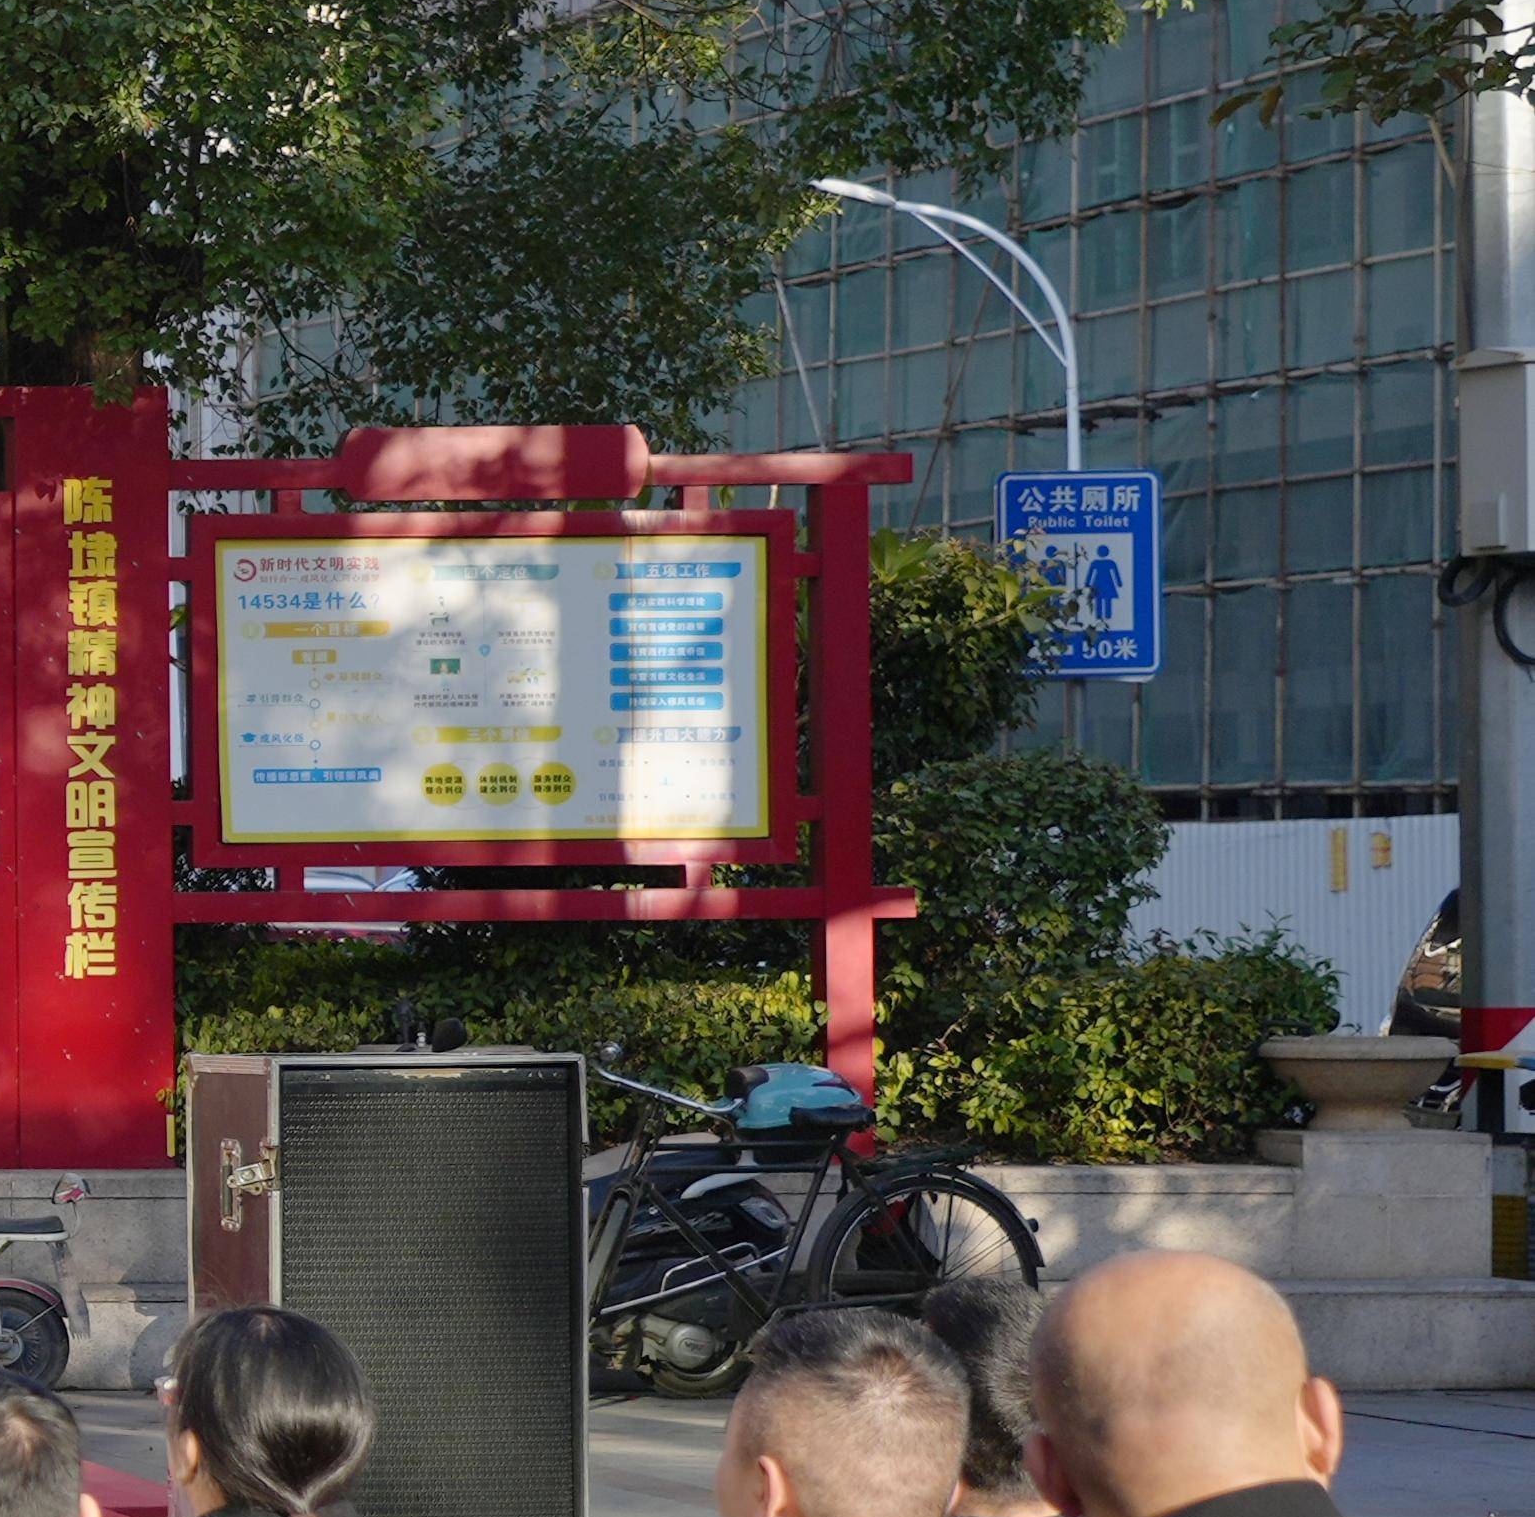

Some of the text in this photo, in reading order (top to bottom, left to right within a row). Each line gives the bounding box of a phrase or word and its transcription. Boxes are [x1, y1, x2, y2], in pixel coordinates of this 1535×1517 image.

[1017, 485, 1141, 513] 公共厕所
[1028, 515, 1130, 528] Public Toilet
[259, 556, 380, 572] 新时代文明实践
[646, 564, 711, 578] 五项工作
[63, 477, 118, 980] 陈埭镇精神文明宣传栏
